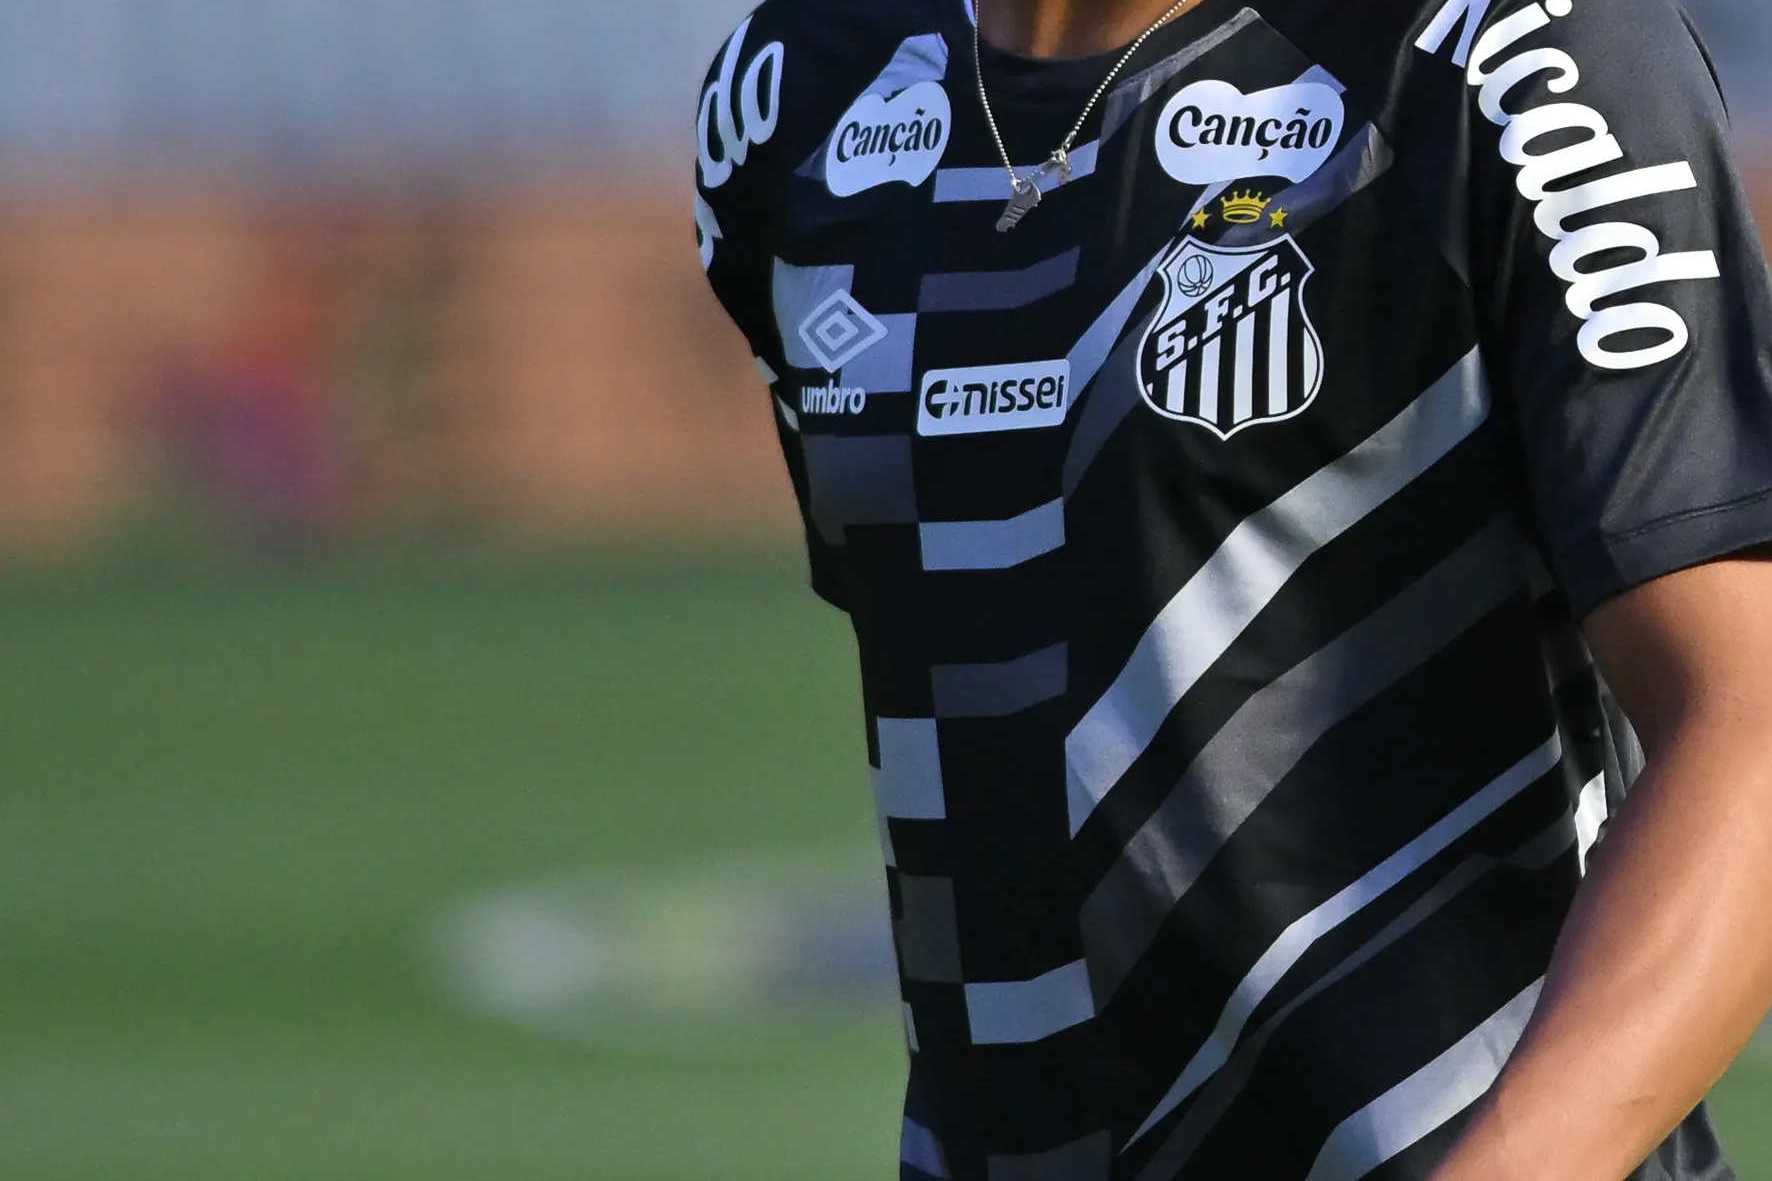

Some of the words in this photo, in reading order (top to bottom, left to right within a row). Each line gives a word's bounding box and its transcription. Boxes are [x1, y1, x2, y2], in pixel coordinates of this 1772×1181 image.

[836, 108, 942, 167] Canção
[1168, 107, 1333, 161] Canção
[802, 379, 866, 414] umbro
[963, 375, 1064, 417] nissei
